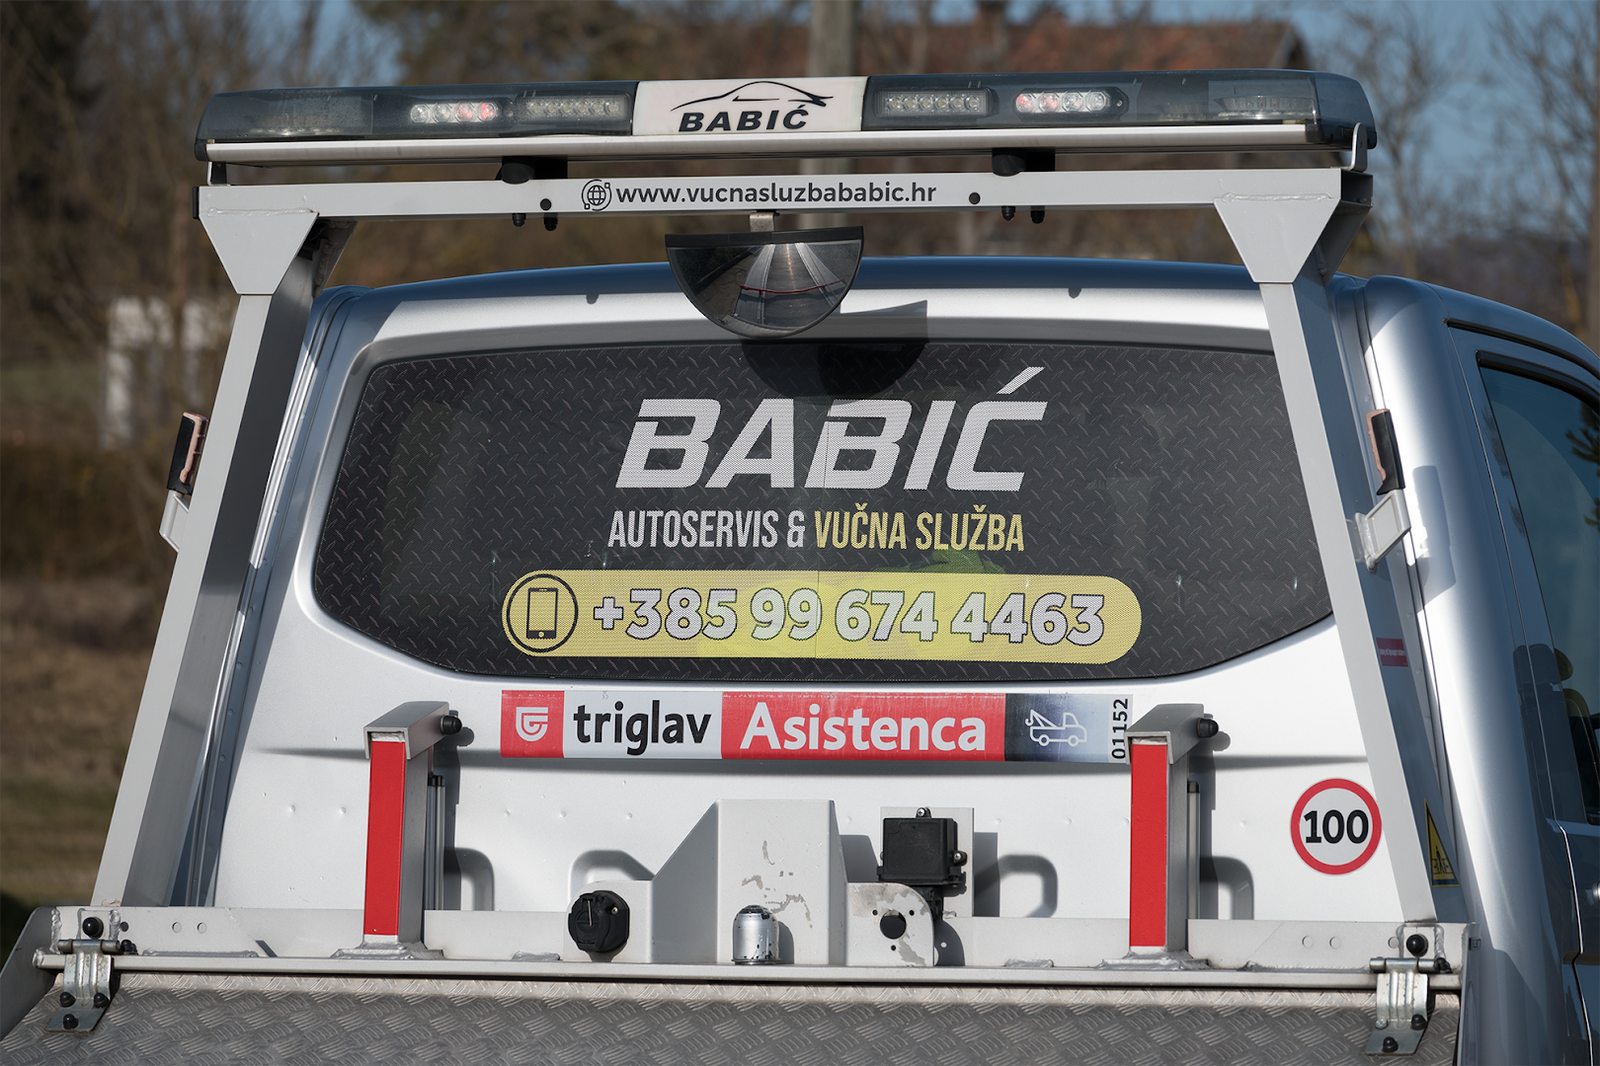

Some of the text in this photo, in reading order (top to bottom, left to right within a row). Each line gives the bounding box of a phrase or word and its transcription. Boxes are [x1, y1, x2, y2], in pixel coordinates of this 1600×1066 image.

[678, 104, 809, 132] BABIĆ
[615, 181, 937, 204] www.vucnasluzbababic.hr
[615, 366, 1048, 492] BABIĆ
[607, 502, 1025, 552] AUTOSERVIS & VUČNA SLUŽBA
[593, 588, 1106, 647] +385 99 674 4463
[573, 699, 986, 756] triglav Asistenca
[1111, 698, 1128, 760] 01152
[1303, 809, 1369, 844] 100
